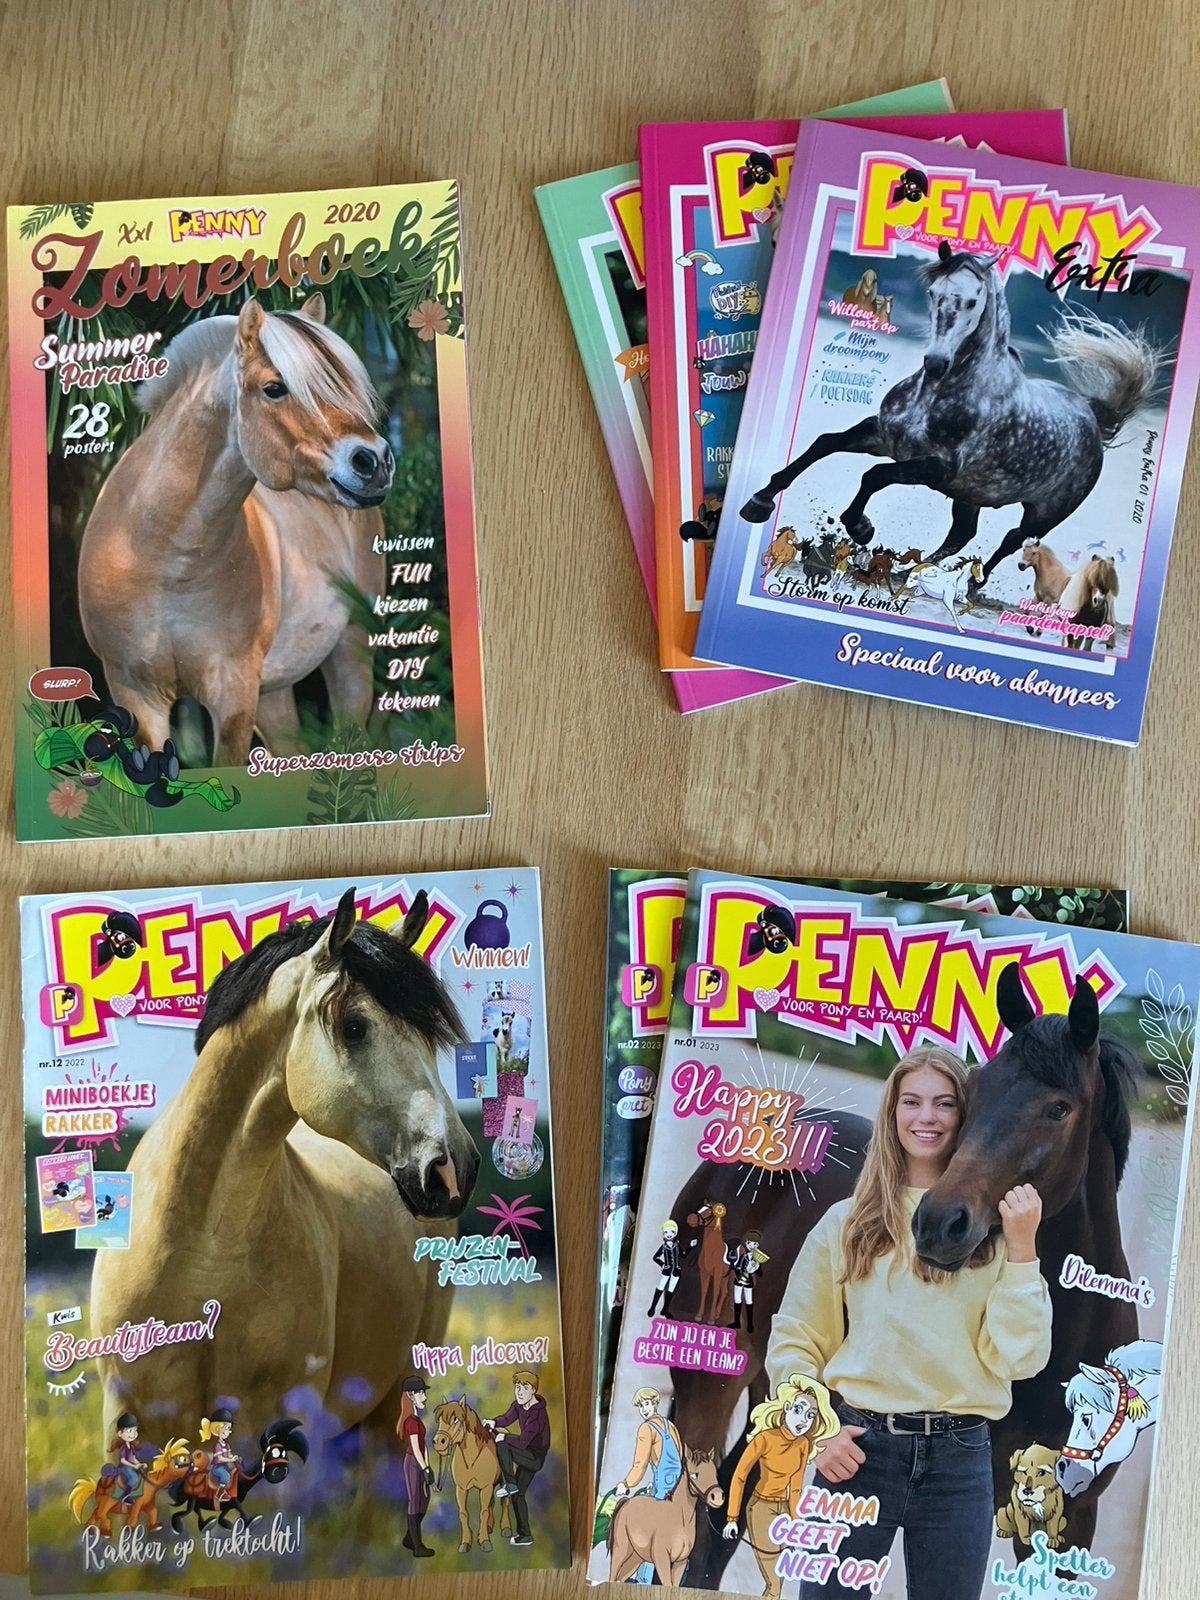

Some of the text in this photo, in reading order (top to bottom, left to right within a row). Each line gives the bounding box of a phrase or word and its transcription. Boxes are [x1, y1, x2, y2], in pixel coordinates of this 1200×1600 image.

[168, 208, 267, 243] PENNY
[323, 200, 381, 225] 2020
[862, 160, 1148, 290] PENNY
[915, 230, 939, 244] VOOR
[30, 200, 436, 320] Zomerboek
[1045, 240, 1163, 303] Extra
[717, 292, 739, 311] DIY
[827, 300, 876, 320] Willow
[847, 331, 877, 348] Mijn
[880, 322, 899, 335] op
[33, 331, 162, 370] Summer
[823, 343, 890, 363] droompony
[59, 353, 170, 394] Paradise
[63, 403, 109, 439] 28
[64, 437, 115, 458] posters
[1138, 483, 1150, 496] 01
[1132, 498, 1146, 525] 2020
[372, 534, 435, 555] kwissen
[390, 562, 432, 586] FUN
[373, 594, 429, 616] kiezen
[767, 576, 914, 616] Storm op komst
[368, 624, 440, 648] vakantie
[999, 611, 1115, 639] paardenkapsel?
[386, 656, 430, 680] DIY
[836, 631, 1121, 711] Speciaal voor abonnees
[43, 678, 82, 689] SLURP!
[378, 692, 441, 712] tekenen
[248, 739, 465, 777] Superzomerse strips
[452, 943, 532, 969] Winnen!
[139, 994, 208, 1012] VOOR PONY
[782, 998, 923, 1024] VOOR PONY EN PAARD!
[618, 1040, 661, 1049] nr.02 2023
[674, 1038, 720, 1052] nr.01 2023
[39, 1058, 85, 1068] nr.12 2022
[620, 1068, 653, 1091] Pony
[45, 1083, 149, 1106] MINIBOEKJE
[674, 1062, 798, 1129] Happy
[46, 1112, 113, 1132] RAKKER
[700, 1123, 828, 1168] 2023!!!
[414, 1236, 518, 1262] PRIJZEN-
[438, 1257, 542, 1286] FESTIVAL
[1062, 1257, 1151, 1305] Dilemma's
[53, 1311, 76, 1325] Kwis
[44, 1300, 221, 1371] Beautyteam?
[653, 1322, 733, 1349] ZIJN JIJ EN JE
[412, 1336, 550, 1376] Pippa jaloers?!
[637, 1341, 744, 1371] BESTIE EEN TEAM?
[799, 1488, 877, 1523] EMMA
[81, 1511, 302, 1570] Rakker op trektocht!
[771, 1516, 847, 1551] GEEFT
[1033, 1533, 1112, 1576] Spetter
[778, 1552, 888, 1592] NIET OP!
[994, 1561, 1094, 1597] helpt een
